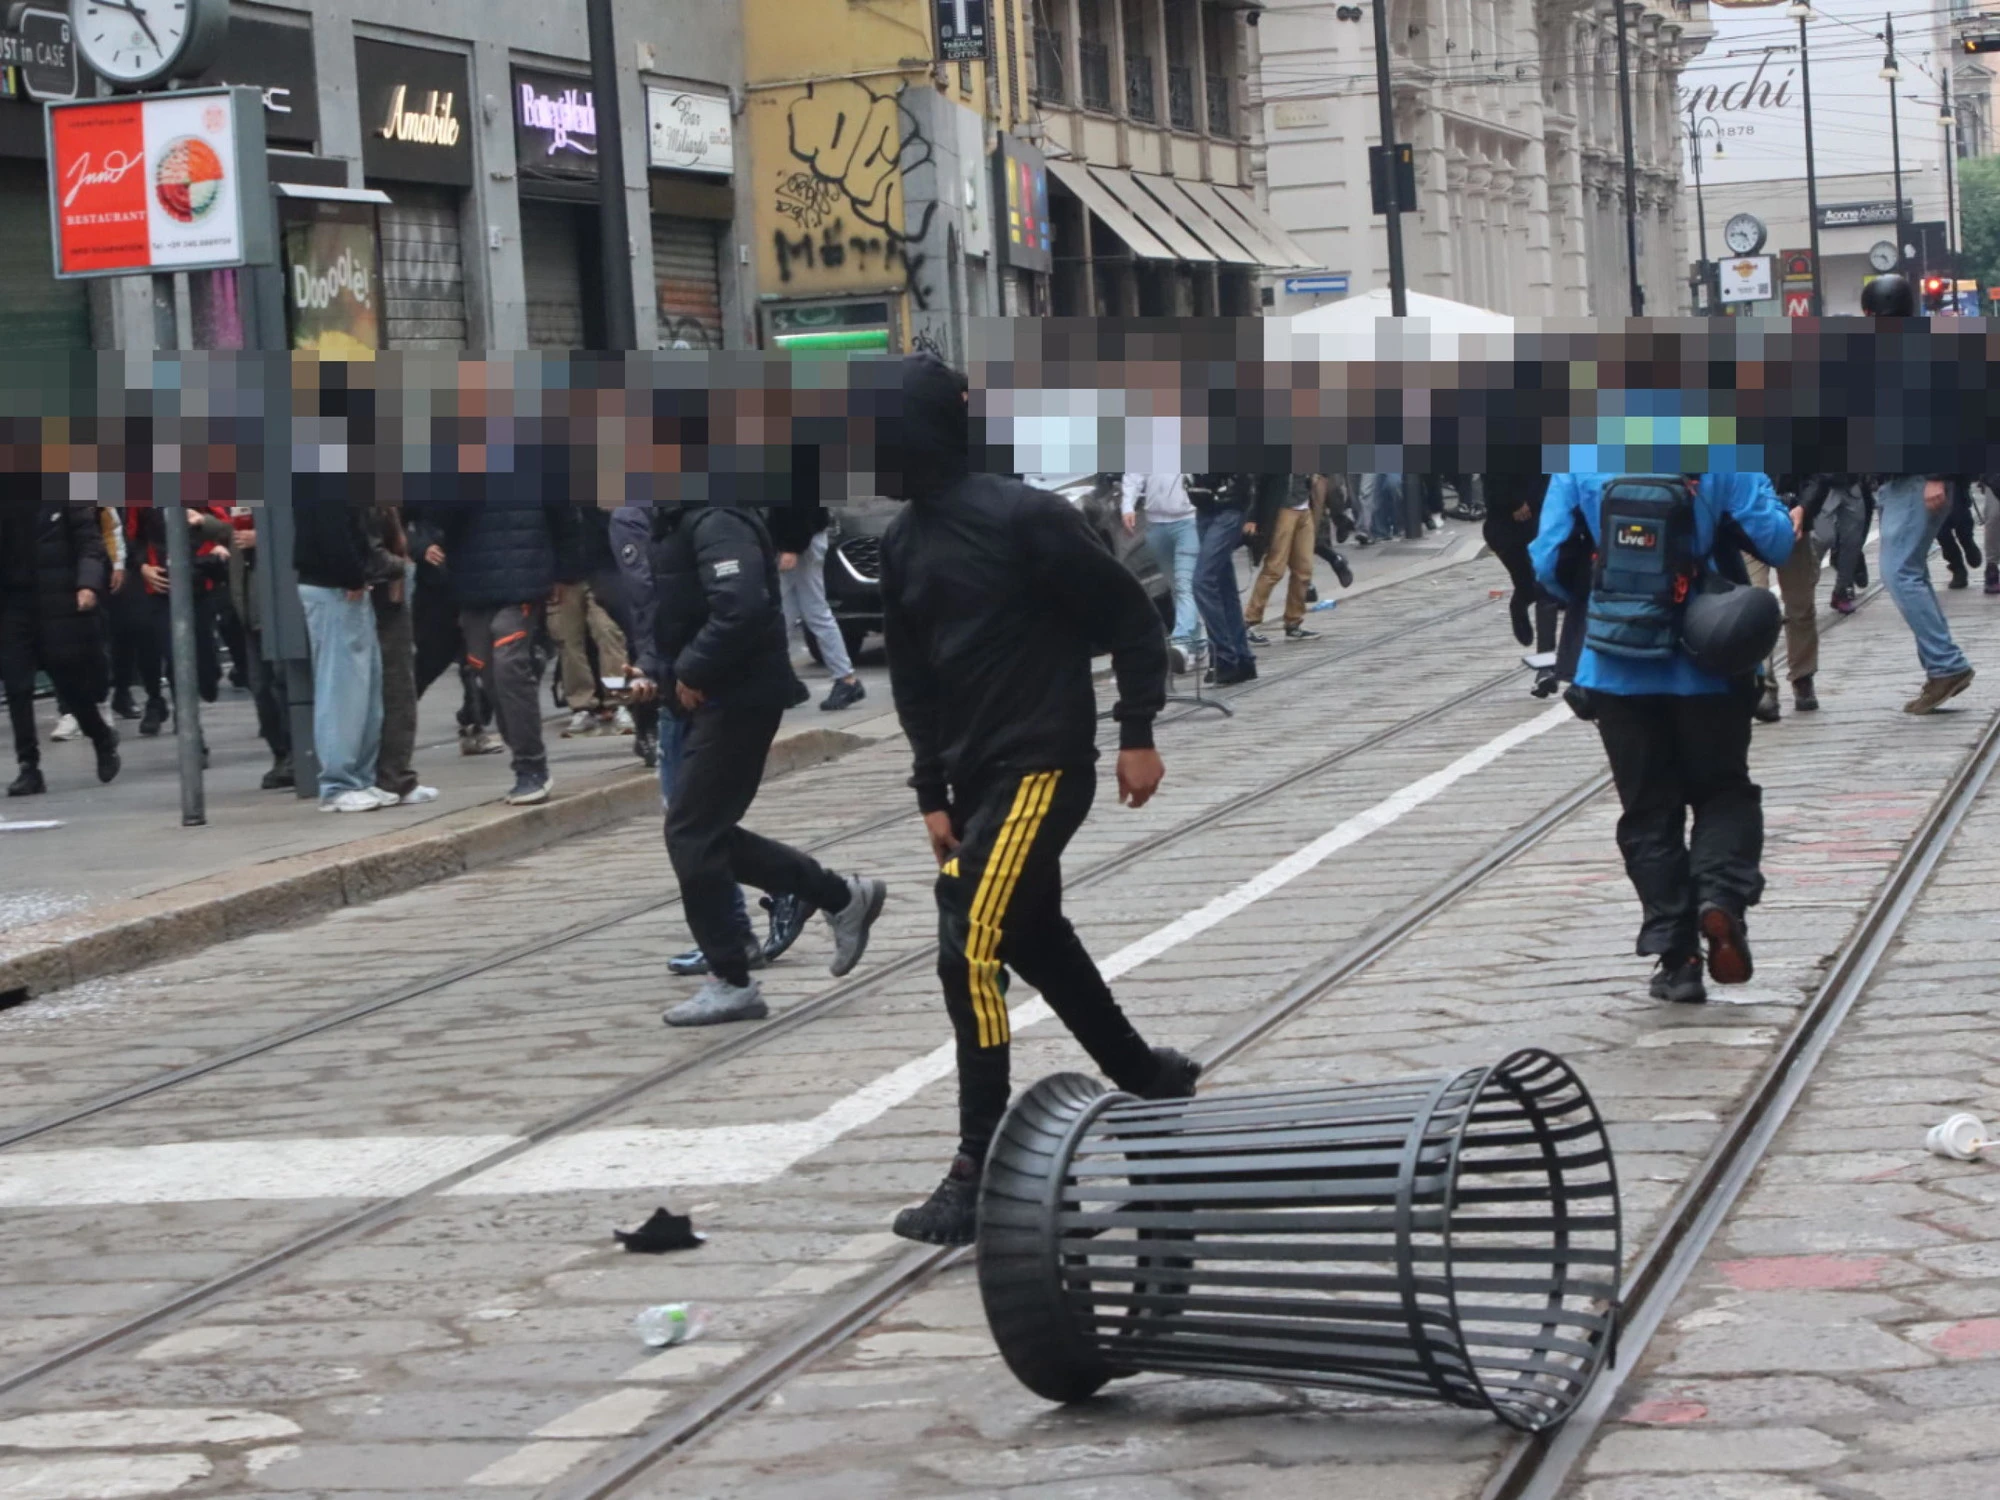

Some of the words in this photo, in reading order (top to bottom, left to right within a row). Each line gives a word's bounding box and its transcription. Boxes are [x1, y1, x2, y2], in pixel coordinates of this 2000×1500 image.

[36, 41, 66, 68] CASE
[1678, 51, 1795, 113] enchi
[383, 84, 460, 146] Amabile
[1720, 125, 1756, 138] 1878
[66, 210, 146, 226] RESTAURANT
[1617, 529, 1656, 547] LiveU
